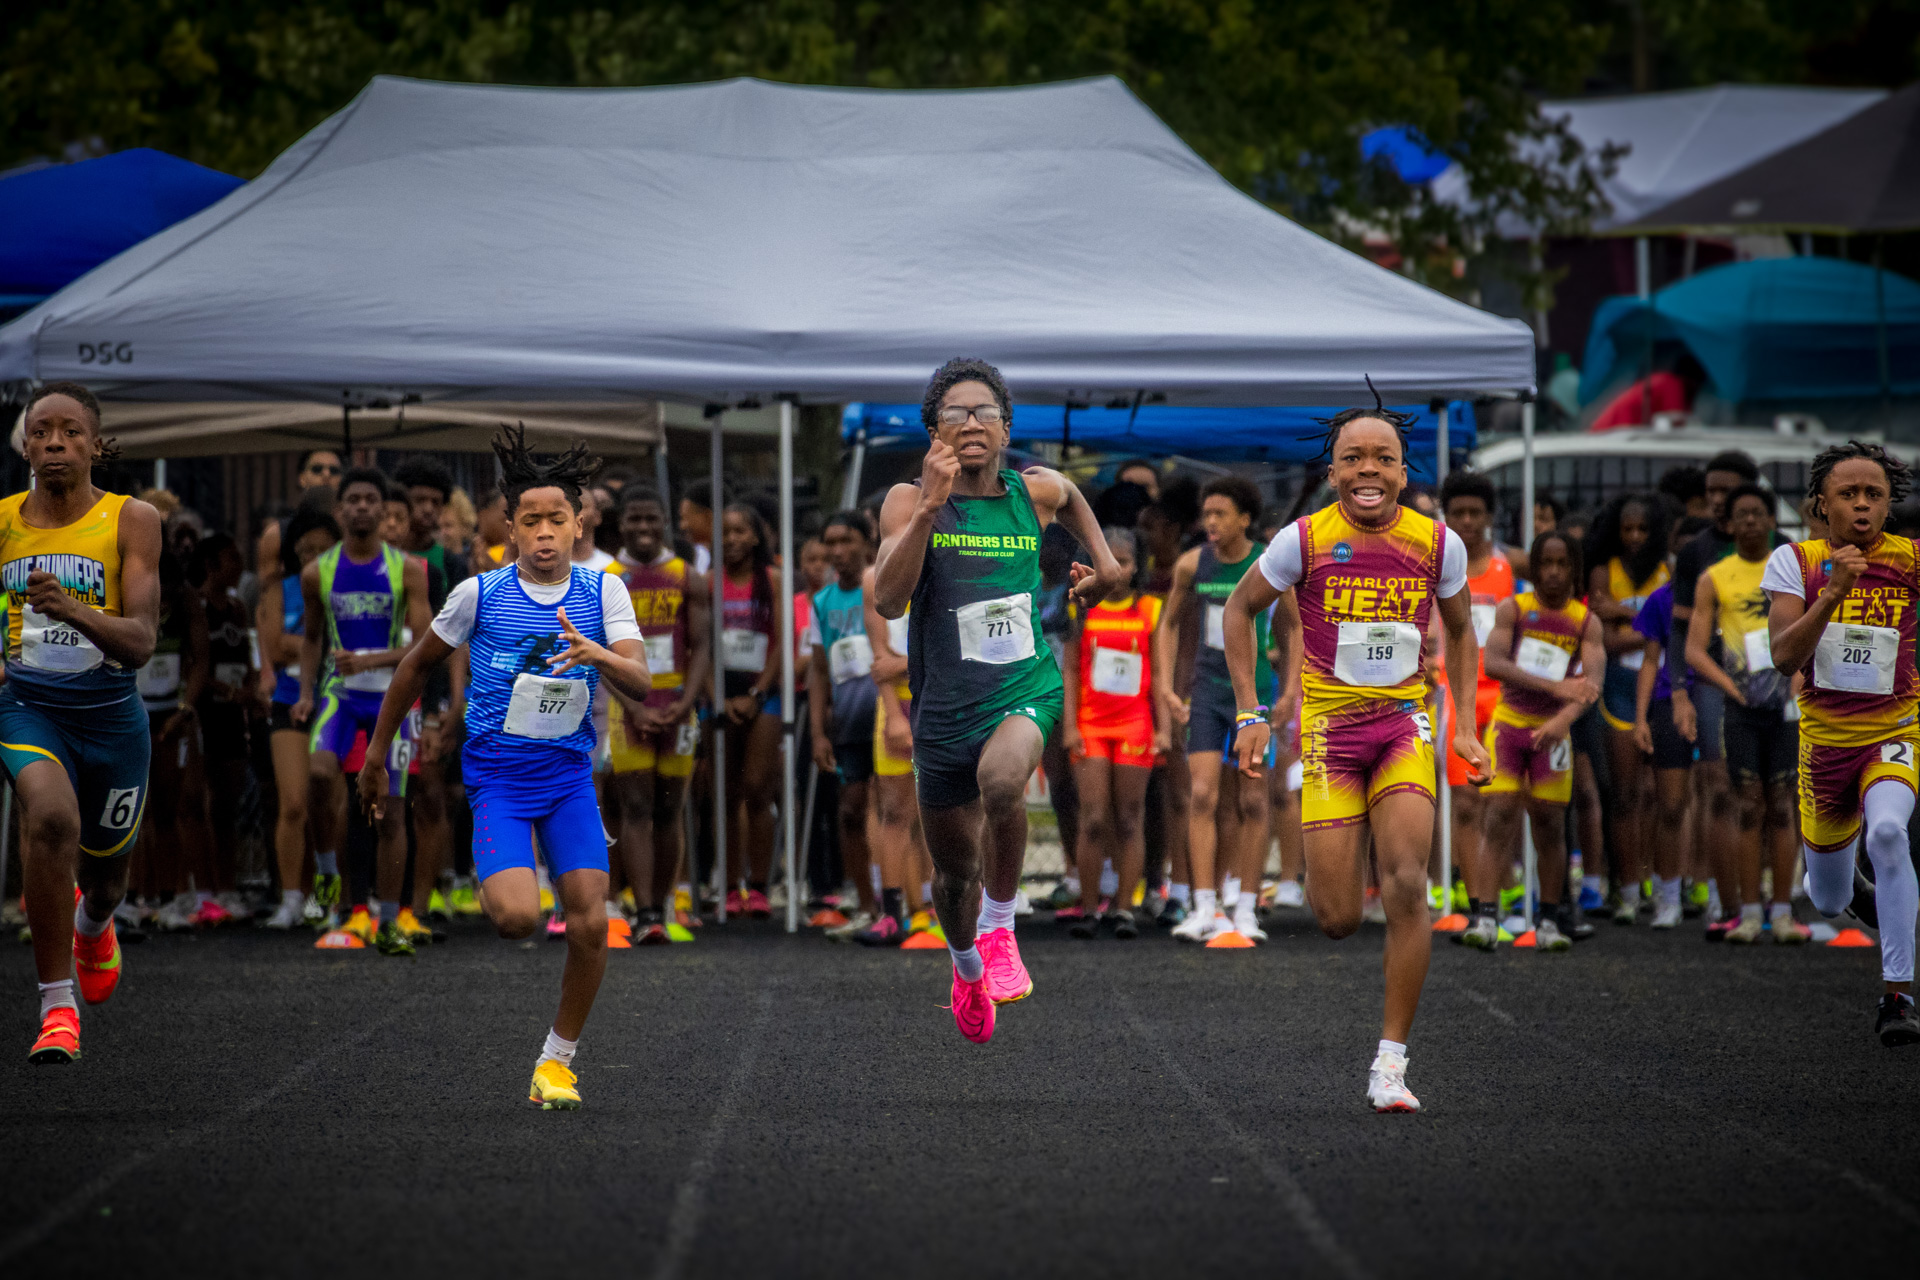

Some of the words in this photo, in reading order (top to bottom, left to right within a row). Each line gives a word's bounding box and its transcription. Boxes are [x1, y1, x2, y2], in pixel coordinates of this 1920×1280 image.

[79, 341, 133, 365] DSG
[933, 533, 1000, 548] PANTHERS
[1003, 536, 1037, 551] ELITE
[2, 557, 33, 594] TRUE
[1325, 576, 1427, 590] CHARLOTTE
[1818, 587, 1909, 598] CRLOTTE
[987, 620, 1013, 637] 771
[42, 629, 79, 646] 1226
[1366, 645, 1394, 660] 159
[1842, 647, 1872, 664] 202
[538, 699, 567, 714] 577
[398, 743, 409, 769] 6
[1889, 740, 1910, 766] 2
[110, 790, 134, 828] 6
